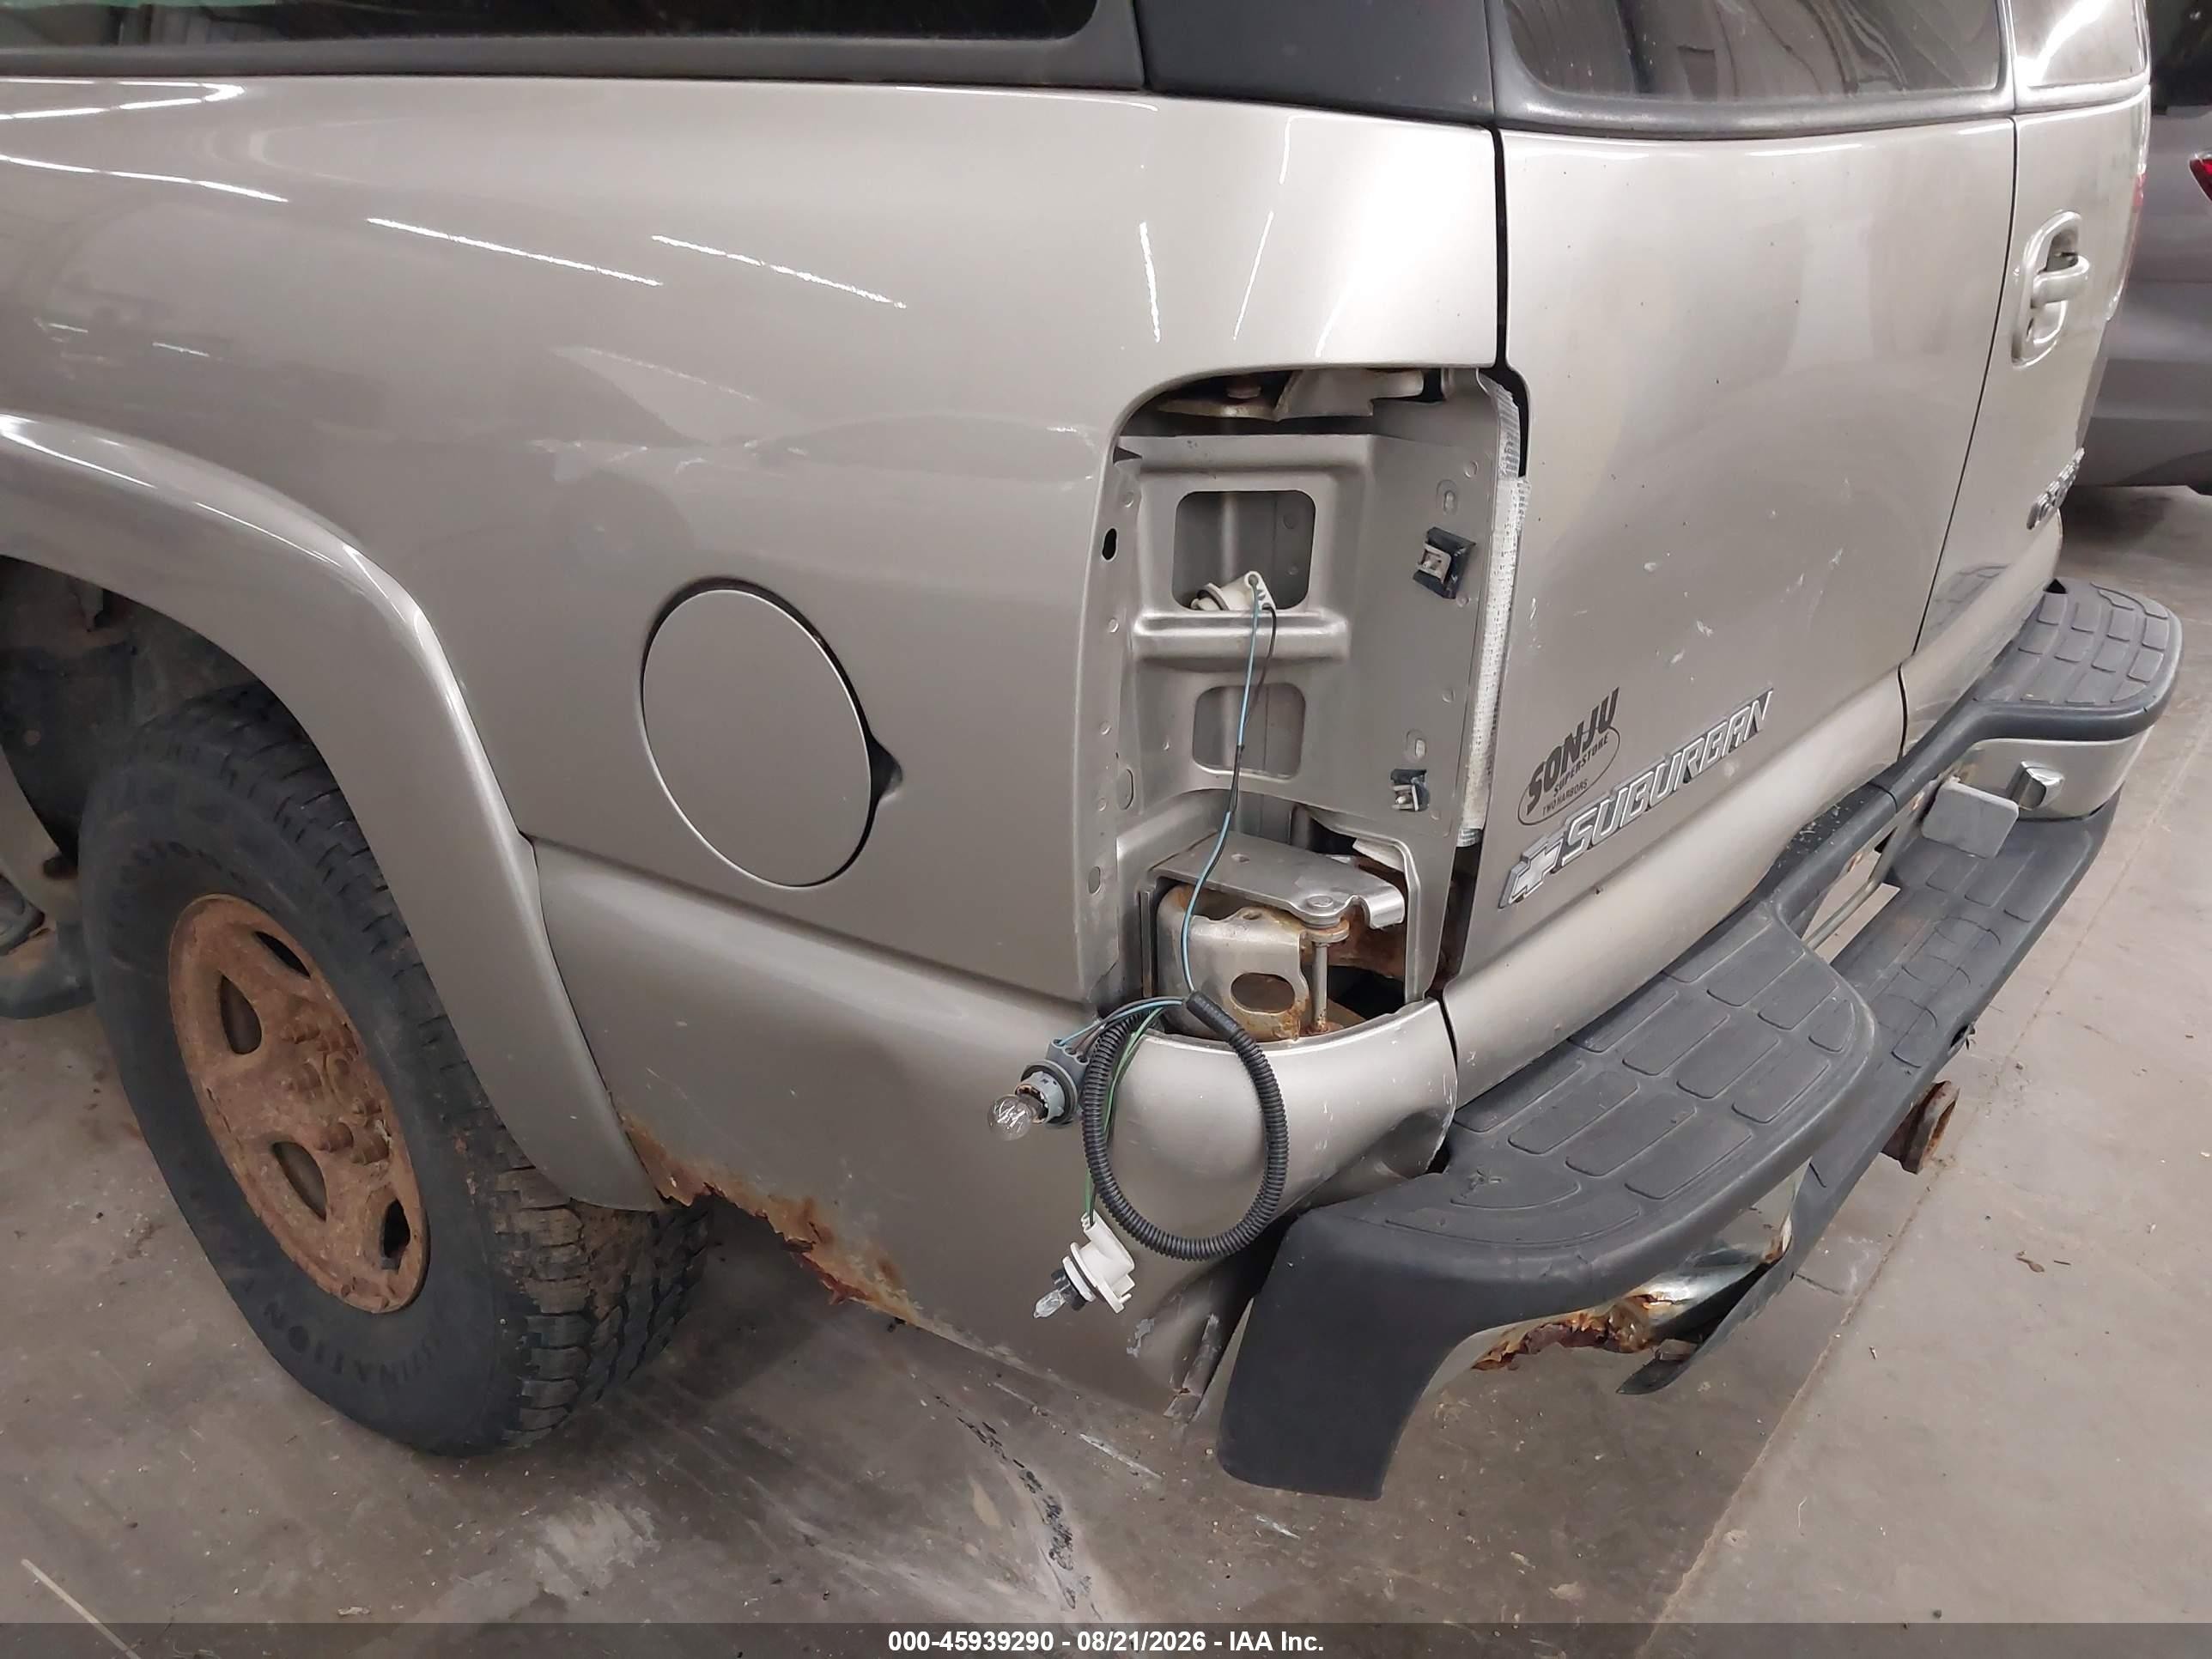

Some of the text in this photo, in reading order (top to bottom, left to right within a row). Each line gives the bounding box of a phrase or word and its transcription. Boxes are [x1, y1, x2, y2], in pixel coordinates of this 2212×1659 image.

[1527, 687, 1619, 816] SONJU
[1553, 732, 1609, 797] SUPERSTORE
[1560, 689, 1773, 866] SUBURBAN
